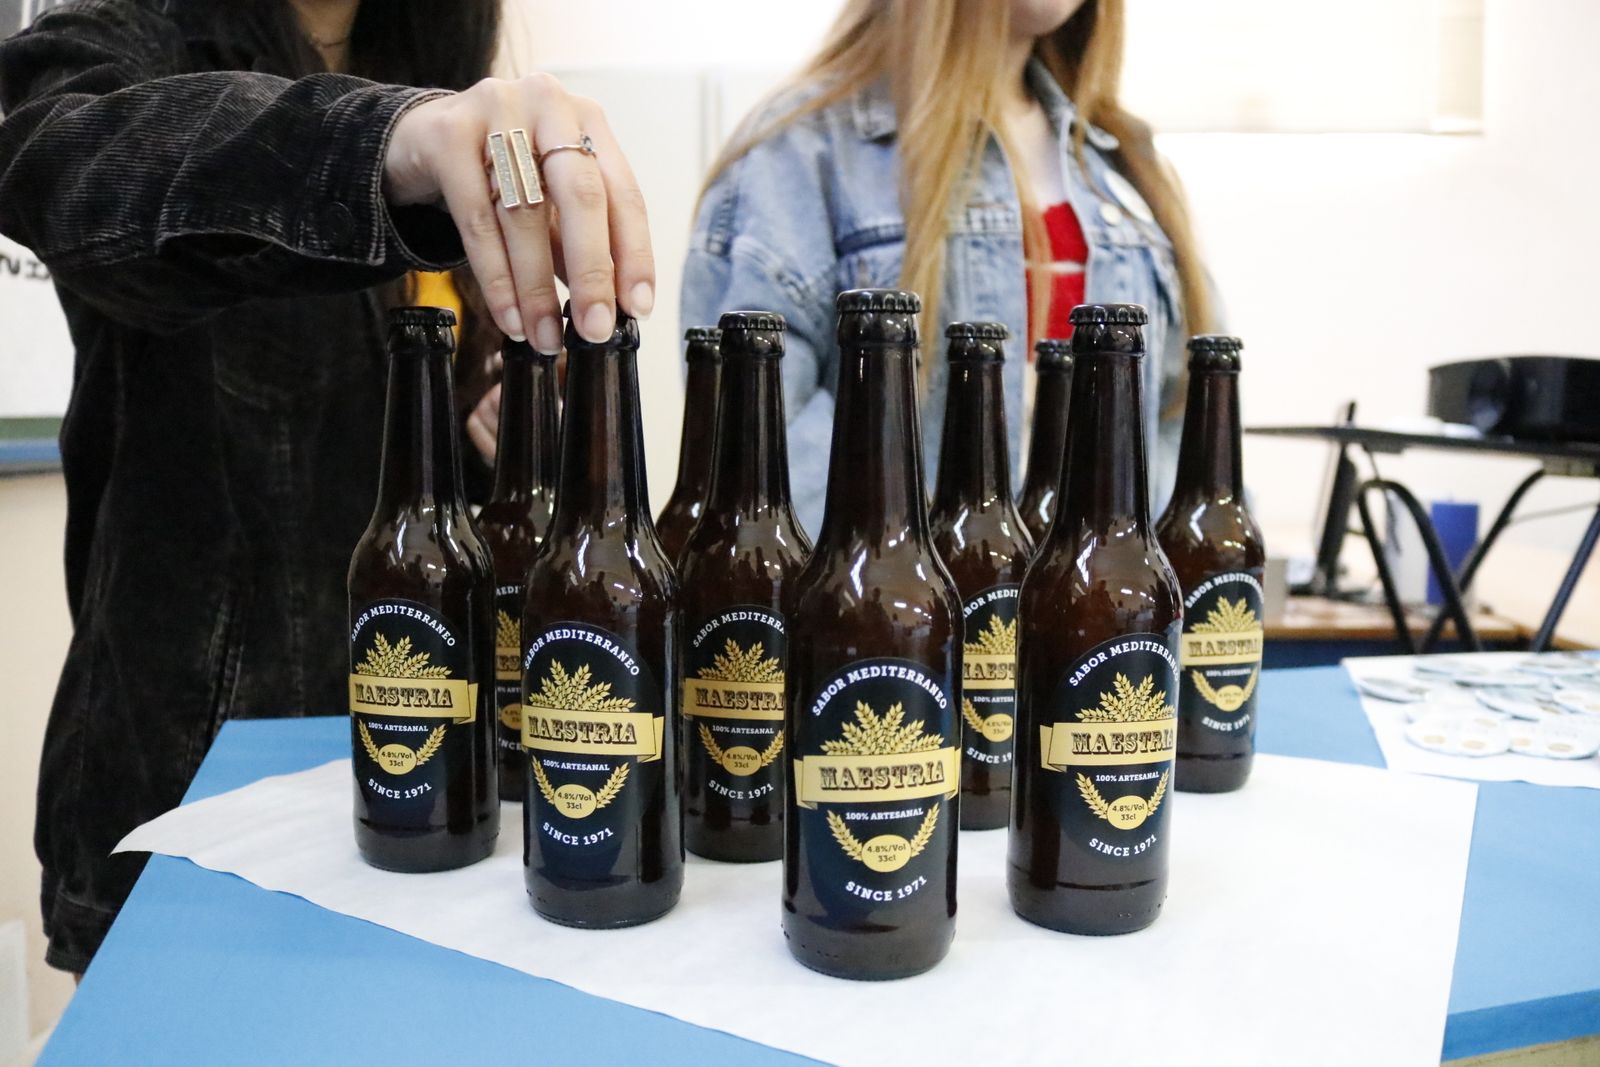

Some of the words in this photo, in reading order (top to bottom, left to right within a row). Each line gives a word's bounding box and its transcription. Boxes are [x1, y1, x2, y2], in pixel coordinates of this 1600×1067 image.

[351, 613, 370, 642] SABOR
[370, 605, 455, 647] MEDITERRANEO
[693, 619, 720, 648] SABOR
[524, 637, 545, 670] SABOR
[545, 628, 640, 676] MEDITERRANEO
[1069, 651, 1108, 686] SABOR
[355, 682, 453, 708] MAESTRIA
[812, 678, 846, 716] SABOR
[847, 665, 947, 710] MEDITERRANEO
[368, 722, 383, 731] 100%
[384, 724, 429, 732] ARTESANAL
[528, 716, 637, 744] MAESTRIA
[712, 725, 730, 733] 100%
[498, 737, 522, 751] NCE
[966, 747, 999, 763] SINCE
[543, 759, 560, 768] 100%
[561, 762, 610, 771] ARTESANAL
[819, 760, 944, 790] MAESTRIA
[1096, 774, 1117, 782] 100%
[1118, 771, 1160, 782] ARTESANAL
[368, 778, 401, 799] SINCE
[404, 782, 432, 799] 1971
[557, 792, 592, 801] 4.8%/Vol
[708, 780, 744, 799] SINCE
[748, 783, 774, 799] 1971
[566, 802, 582, 810] 33cl
[845, 812, 869, 821] 100%
[870, 807, 924, 820] ARTESANAL
[1112, 804, 1144, 812] 4.8%/Vol
[542, 822, 579, 845] SINCE
[583, 827, 614, 845] 1971
[867, 844, 906, 853] 4.8%/Vol
[1089, 838, 1130, 856] SINCE
[1134, 834, 1157, 855] 1971
[878, 855, 896, 863] 33cl
[845, 881, 893, 902] SINCE
[897, 875, 927, 899] 1971
